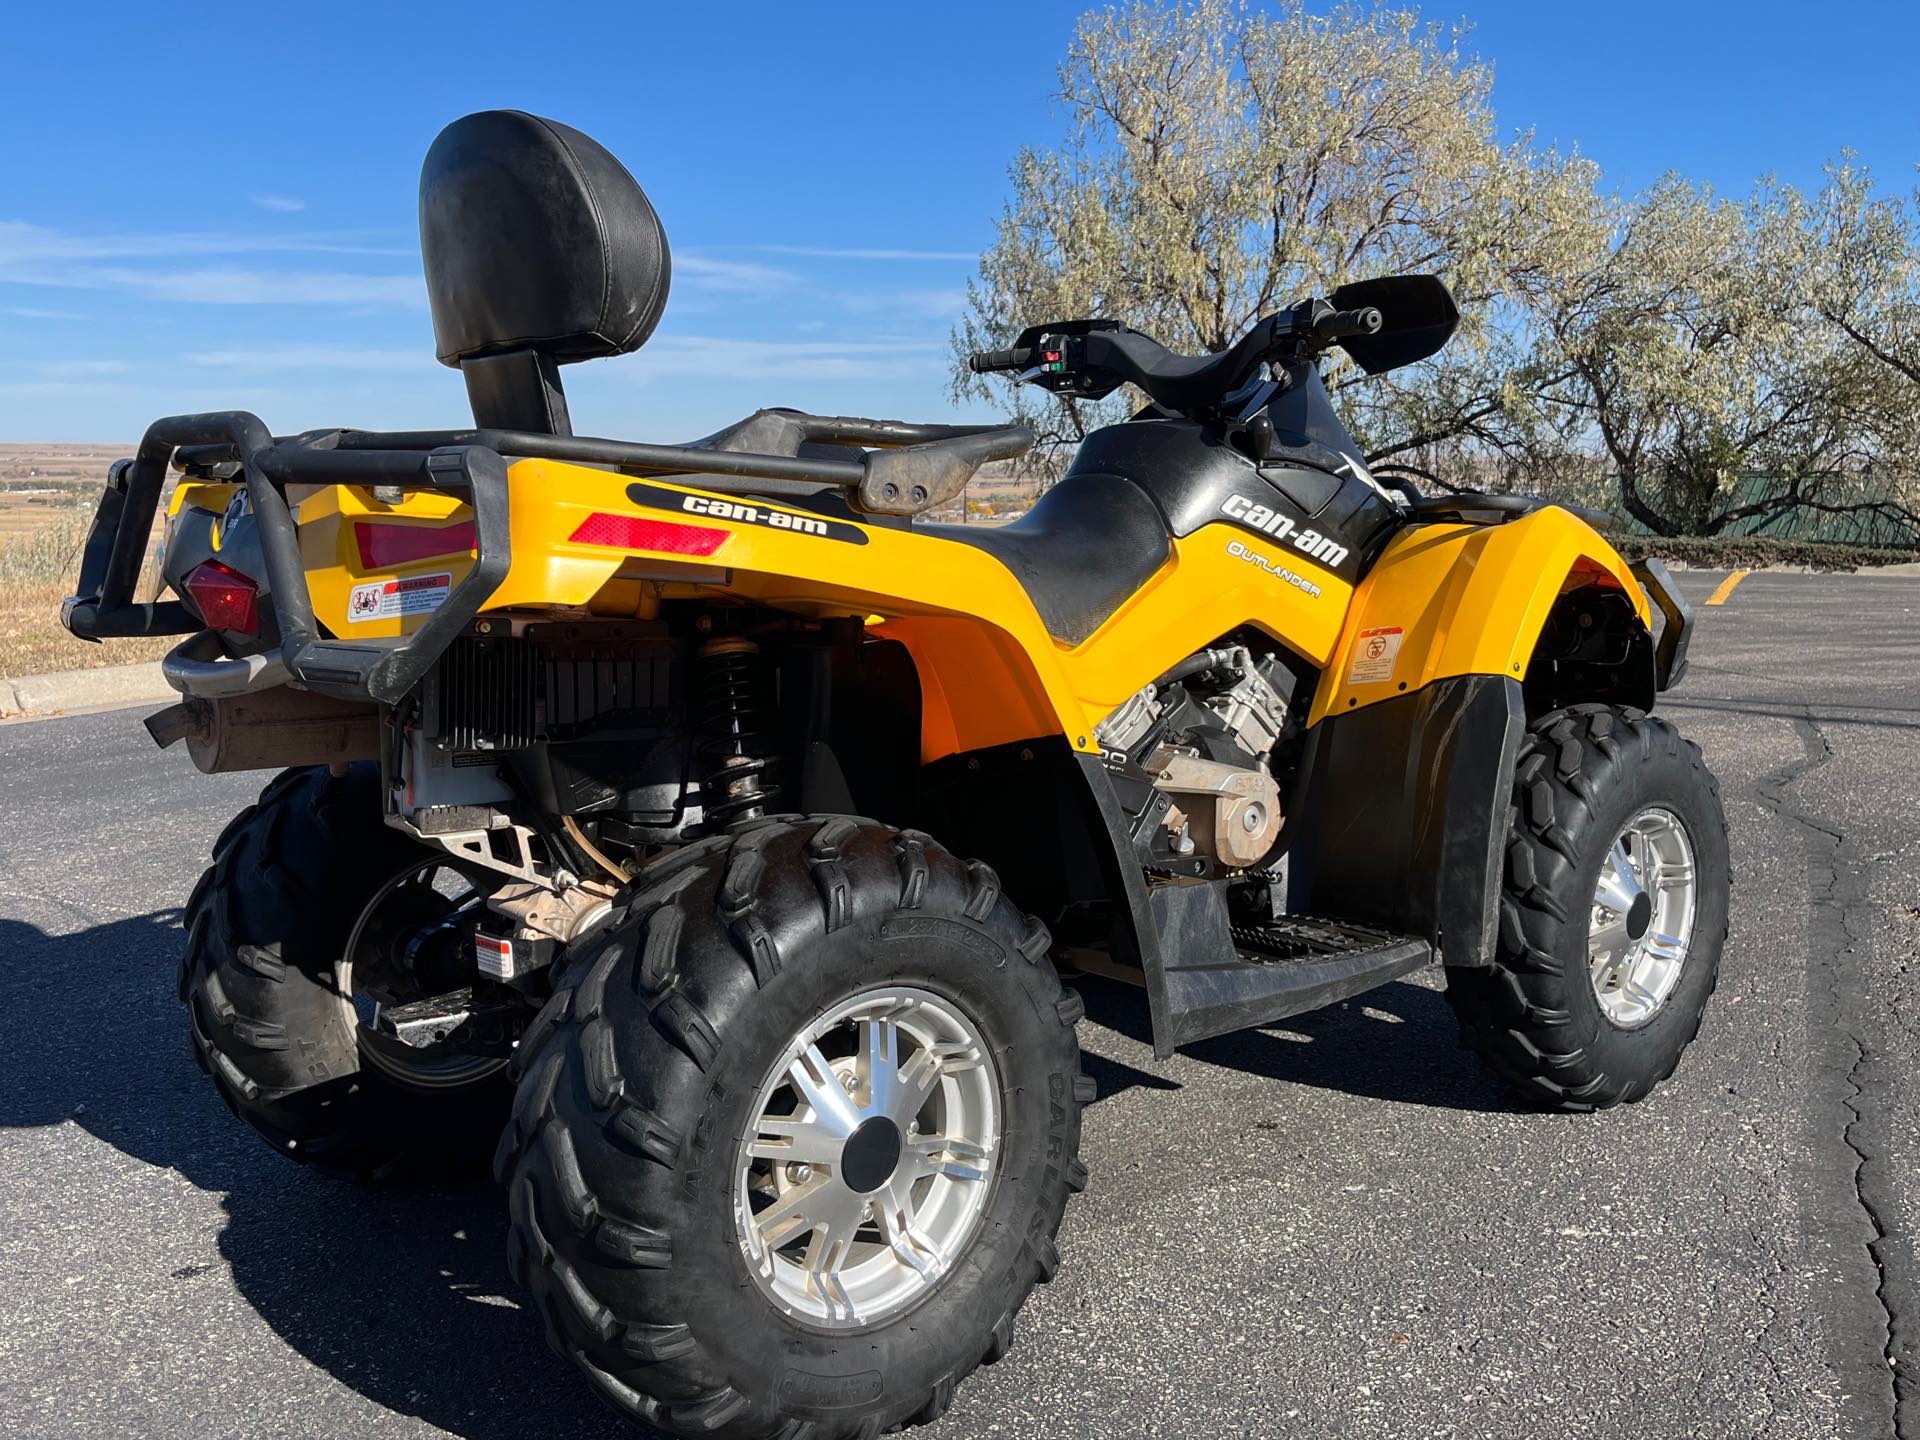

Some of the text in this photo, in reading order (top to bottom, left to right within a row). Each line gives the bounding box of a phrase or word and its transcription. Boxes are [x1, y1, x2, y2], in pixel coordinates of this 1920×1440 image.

[682, 496, 828, 535] can-am
[1221, 493, 1349, 567] can-am
[1227, 541, 1321, 598] OUTLANDER
